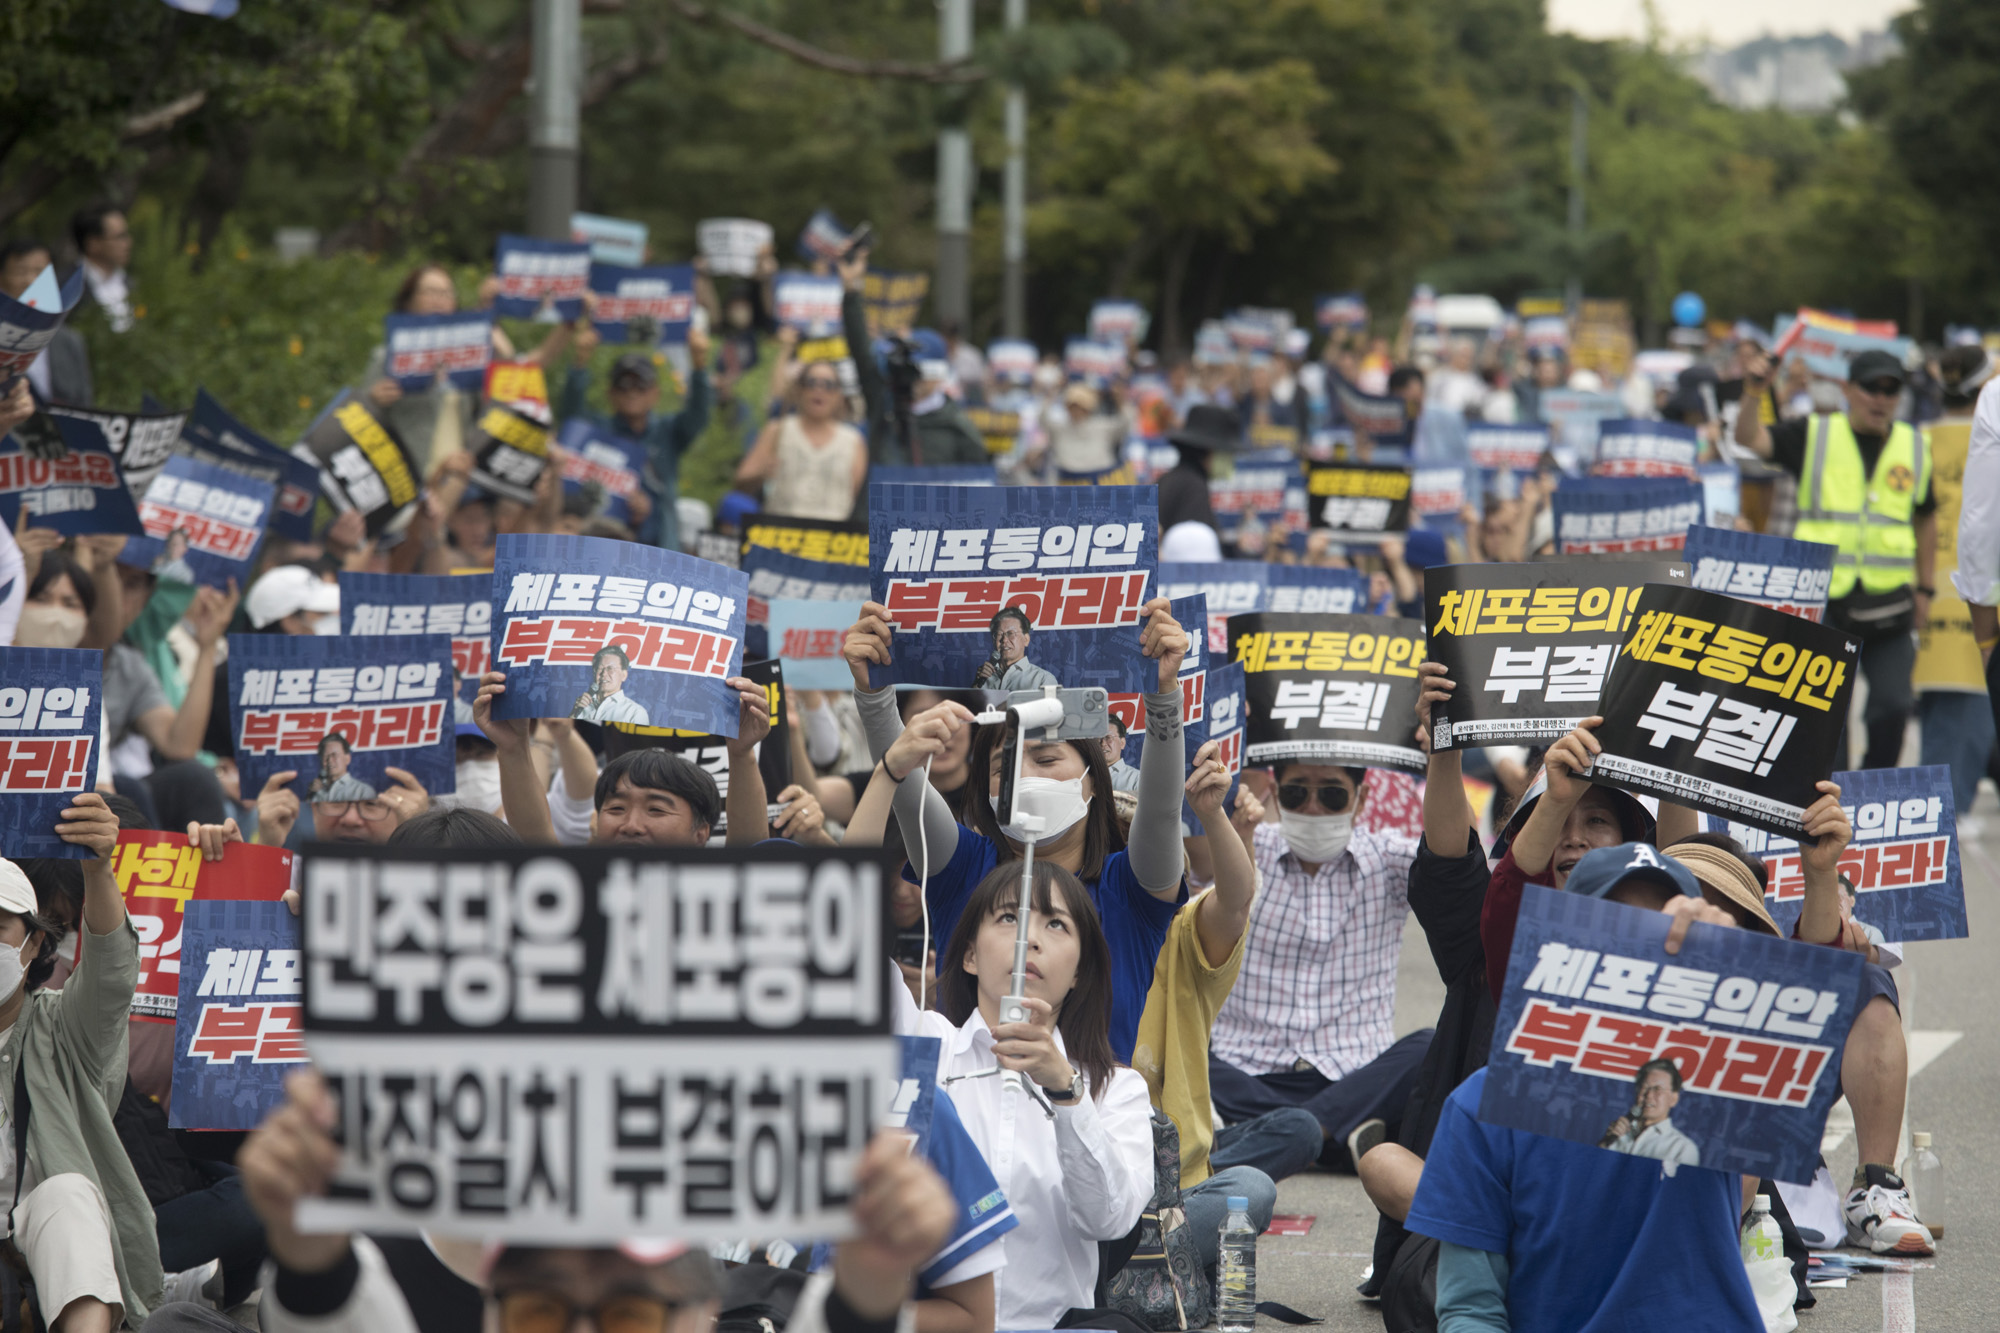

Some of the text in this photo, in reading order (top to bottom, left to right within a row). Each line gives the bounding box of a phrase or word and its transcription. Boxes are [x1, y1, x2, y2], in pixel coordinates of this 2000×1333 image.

[883, 522, 1145, 572] 체포동의안
[503, 573, 736, 630] 체포동의안
[886, 570, 1150, 633] 부결하라!
[1692, 557, 1832, 600] 체포동의안
[1433, 587, 1644, 638] 체포동의
[498, 616, 737, 679] 부결하라!
[1236, 631, 1427, 678] 체포동의안
[1621, 610, 1846, 712] 체포동의안
[240, 662, 442, 705] 체포동의안
[1270, 679, 1391, 732] 부결!
[240, 699, 448, 756] 부결하라!
[1457, 724, 1474, 733] 윤석열
[1491, 722, 1509, 730] 김건희
[1523, 718, 1566, 731] 촛불대행진
[1472, 732, 1493, 740] 신한은행
[1493, 731, 1536, 740] 100-036-164860
[1637, 681, 1798, 778] 부결!
[1609, 770, 1630, 782] 신한은행
[1702, 796, 1716, 805] ARS
[1629, 764, 1648, 776] 김건희
[1648, 769, 1662, 780] 특검
[1662, 770, 1711, 793] 촛불대행진
[1625, 844, 1667, 871] A
[307, 855, 585, 1027] 민주당은
[599, 856, 881, 1028] 체포동의
[1523, 941, 1839, 1039] 체포동의안
[1504, 997, 1835, 1109] 부결하라!
